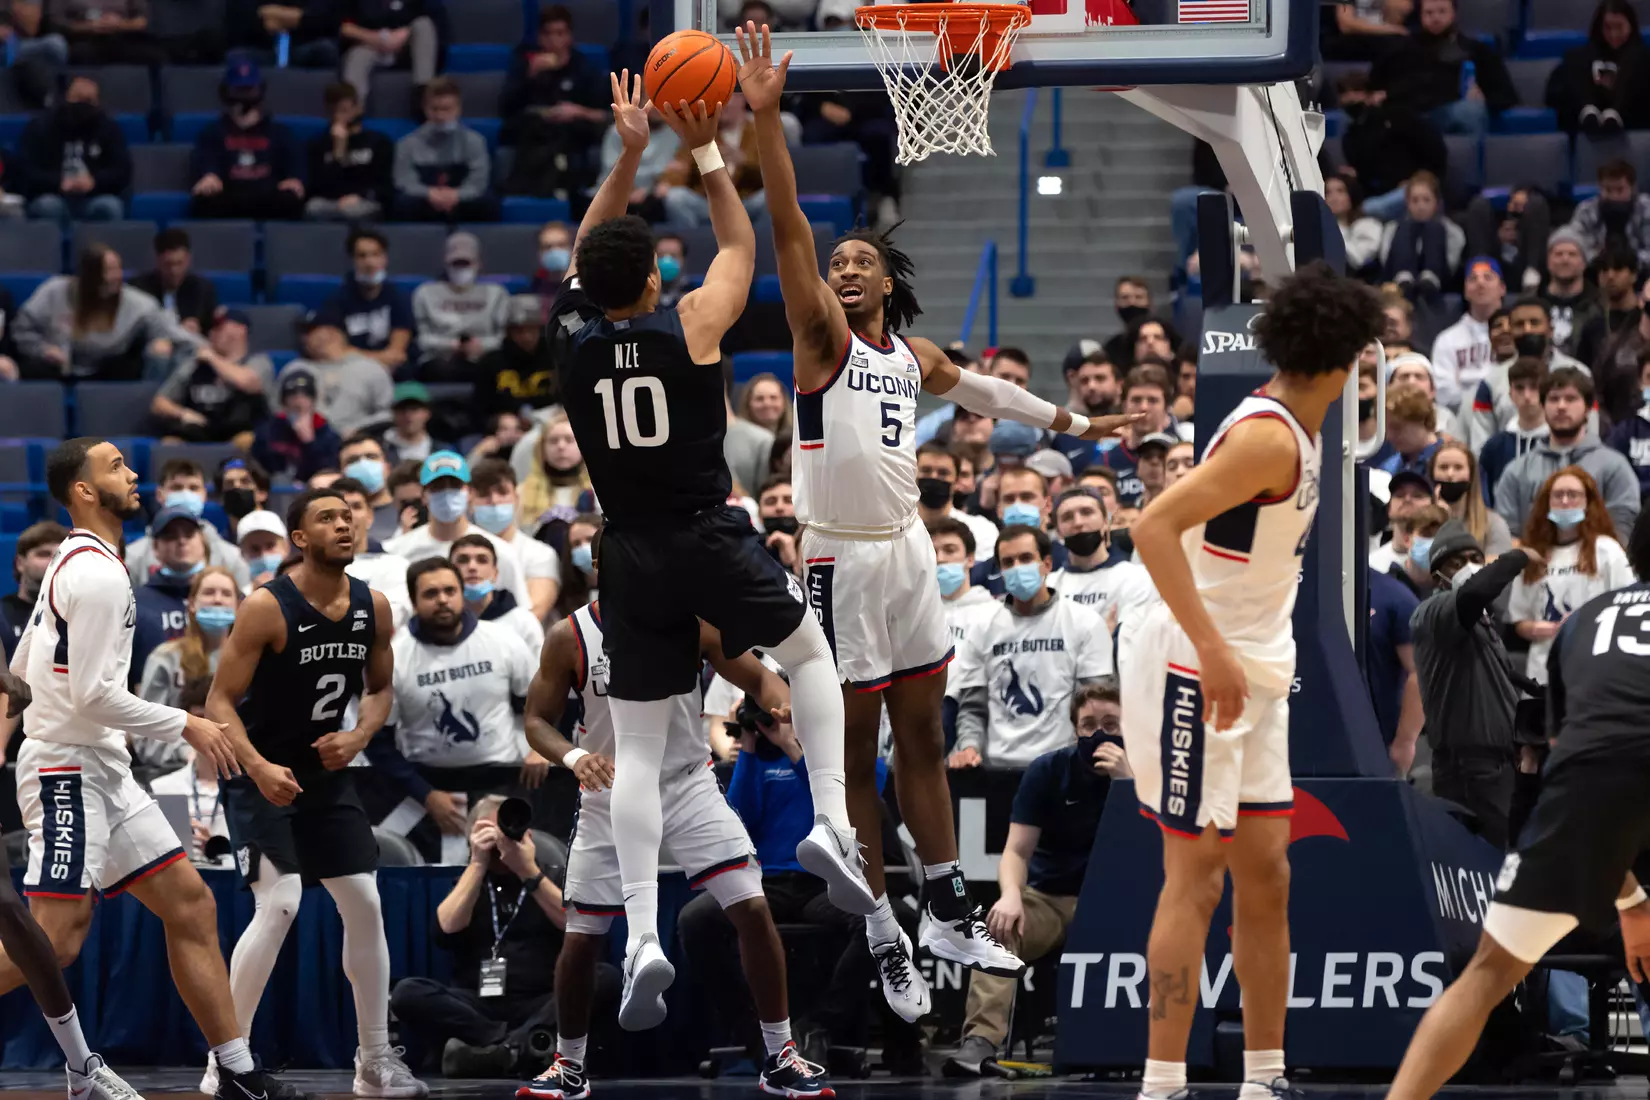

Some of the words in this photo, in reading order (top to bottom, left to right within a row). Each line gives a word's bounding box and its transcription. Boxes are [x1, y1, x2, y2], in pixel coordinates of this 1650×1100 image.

[653, 47, 678, 72] UCONN
[614, 342, 640, 369] NZE
[847, 369, 919, 401] UCONN
[593, 376, 670, 449] 10
[880, 400, 903, 447] 5
[298, 642, 368, 665] BUTLER
[1022, 638, 1064, 653] BUTLER
[1592, 603, 1650, 657] 13
[310, 673, 347, 721] 2
[417, 669, 447, 688] BEAT
[448, 660, 493, 681] BUTLER
[1166, 685, 1197, 818] HUSKIES
[50, 780, 74, 881] HUSKIES
[1060, 950, 1445, 1009] TRVLERS
